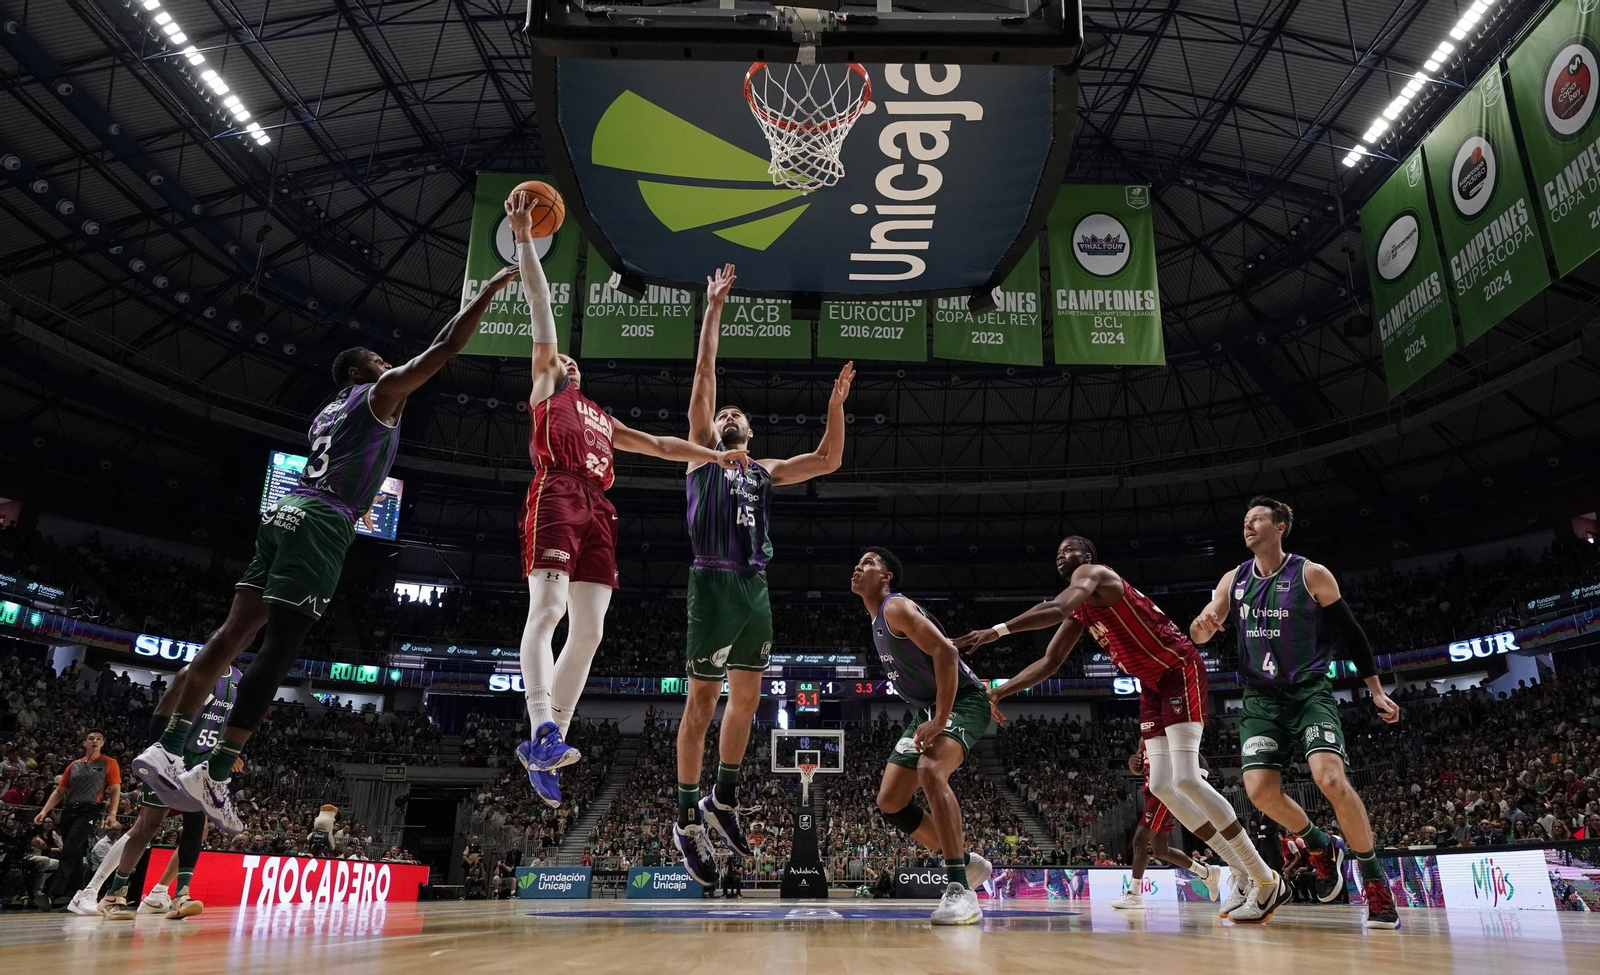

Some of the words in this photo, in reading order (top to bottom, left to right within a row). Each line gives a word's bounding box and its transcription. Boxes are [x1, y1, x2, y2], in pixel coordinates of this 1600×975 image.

[1557, 82, 1577, 103] copa
[849, 63, 984, 282] Unicaja
[1543, 136, 1600, 211] CAMPE
[1550, 189, 1586, 224] COPA
[1102, 243, 1124, 251] FOUR
[1450, 196, 1530, 282] CAMPEONES
[1456, 223, 1535, 297] SUPERCOPA
[1483, 269, 1513, 302] 2024
[1056, 289, 1155, 311] CAMPEONES
[1378, 270, 1442, 342] CAMPEONES
[586, 305, 625, 317] COPA
[629, 306, 659, 317] DEL
[662, 306, 693, 317] REY
[733, 305, 781, 323] ACB
[829, 305, 916, 323] EUROCUP
[936, 311, 974, 324] COPA
[977, 313, 1006, 325] DEL
[1011, 314, 1038, 326] REY
[1395, 297, 1444, 338] INTERCONTINENTAL
[1094, 316, 1123, 328] BCL
[621, 324, 655, 337] 2005
[721, 324, 791, 338] 2005/2006
[840, 324, 904, 340] 2016/2017
[971, 332, 1004, 344] 2023
[1091, 332, 1125, 344] 2024
[1404, 334, 1428, 362] 2024
[307, 435, 332, 478] 3
[275, 511, 286, 520] DEL
[285, 514, 300, 526] SOL
[280, 504, 307, 520] COSTA
[736, 506, 756, 527] 45
[1252, 607, 1290, 620] Unicaja
[1246, 626, 1281, 639] málaga
[1449, 630, 1521, 663] SUR
[1262, 652, 1276, 675] 4
[489, 673, 525, 692] SU
[771, 680, 787, 695] 33
[800, 683, 813, 691] 6.8
[856, 683, 873, 693] 3.3
[797, 692, 818, 706] 3.1
[196, 728, 219, 748] 55
[538, 873, 586, 883] Fundación
[653, 872, 694, 883] Fundaci
[898, 870, 949, 885] endes
[1471, 857, 1514, 908] Mijas
[538, 881, 572, 892] Unicaja
[653, 881, 687, 892] Unicaja
